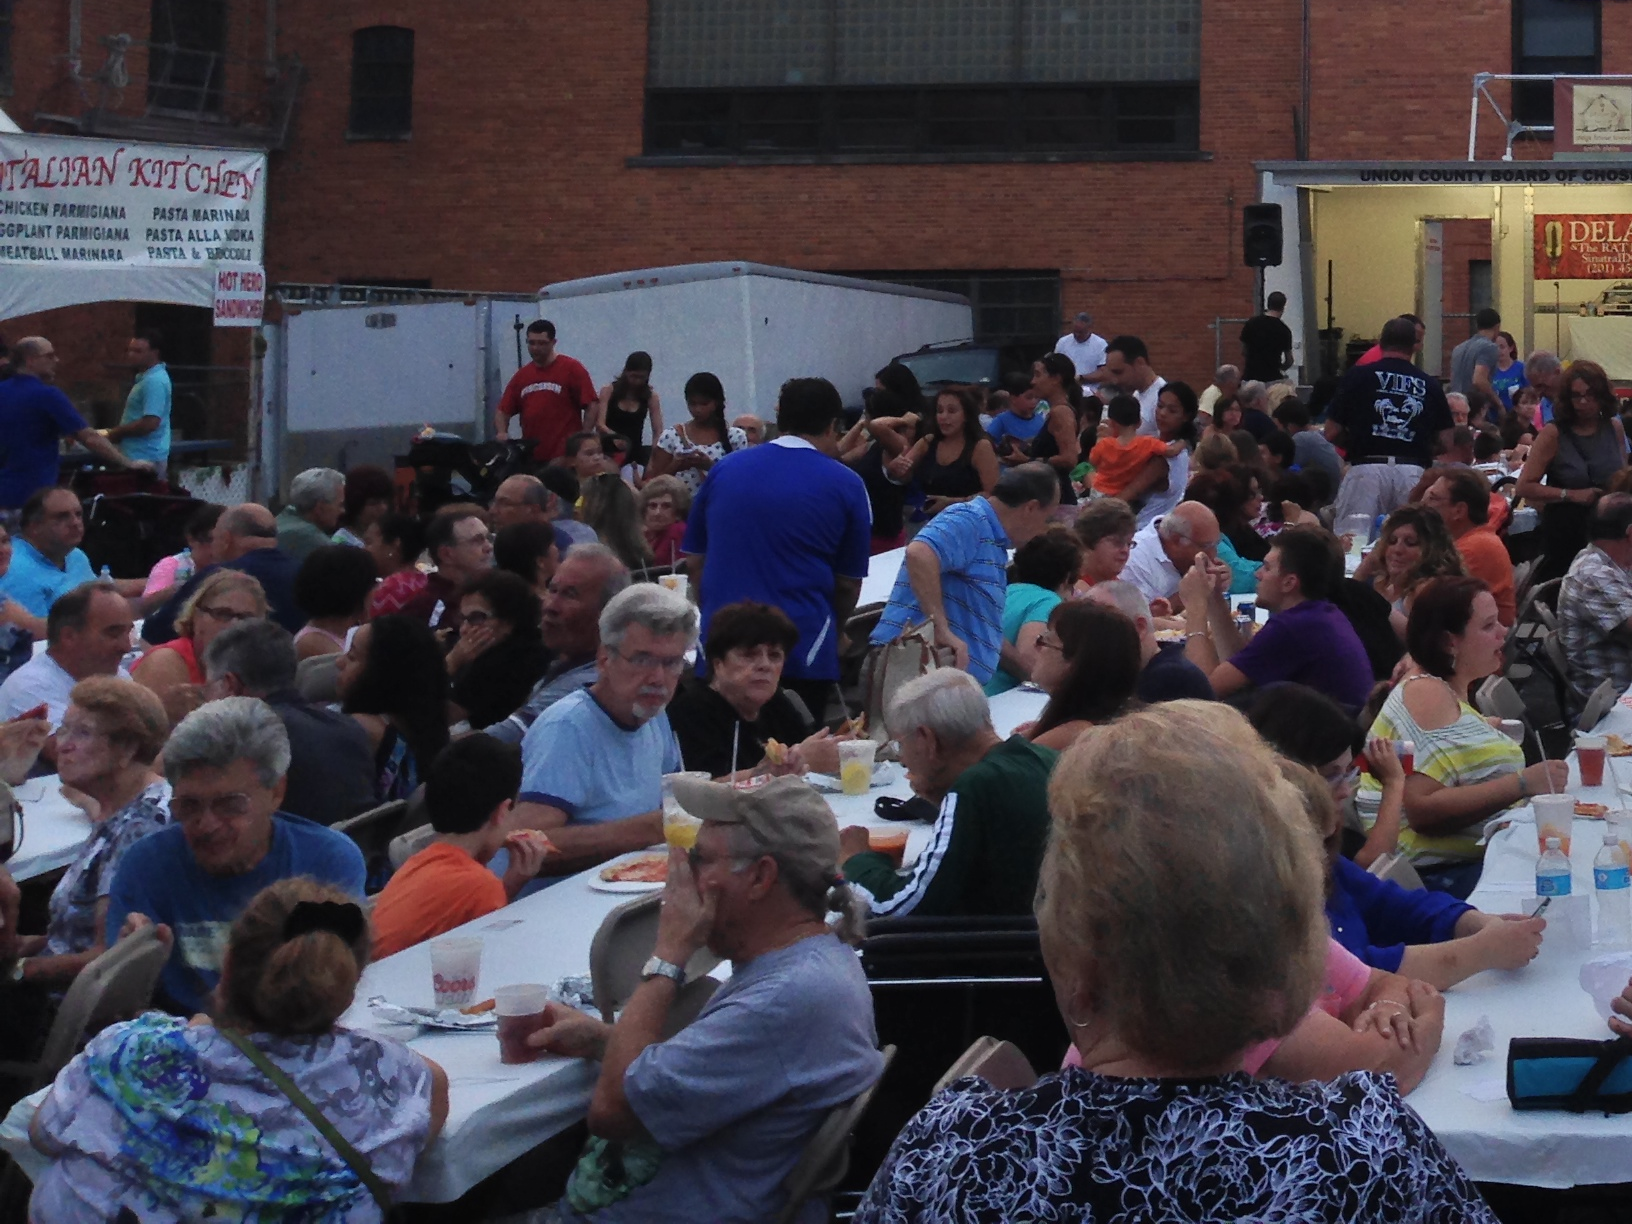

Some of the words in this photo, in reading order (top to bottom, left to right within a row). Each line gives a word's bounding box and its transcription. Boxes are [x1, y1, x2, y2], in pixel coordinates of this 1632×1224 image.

[128, 154, 261, 200] KITCHEN
[1360, 169, 1414, 182] UNION
[1418, 169, 1485, 182] COUNTY
[1491, 169, 1550, 182] BOARD
[1555, 168, 1578, 181] OF
[53, 202, 127, 220] PARMIGIANA
[153, 206, 189, 222] PASTA
[0, 223, 52, 241] GGPLANT
[56, 225, 130, 242] PARMIGIANA
[146, 228, 184, 243] PASTA
[188, 228, 222, 243] ALLA
[61, 247, 124, 261] MARINARA
[147, 246, 188, 260] PASTA
[1602, 242, 1626, 253] RAT
[218, 272, 238, 292] HOT
[433, 972, 476, 994] Coors
